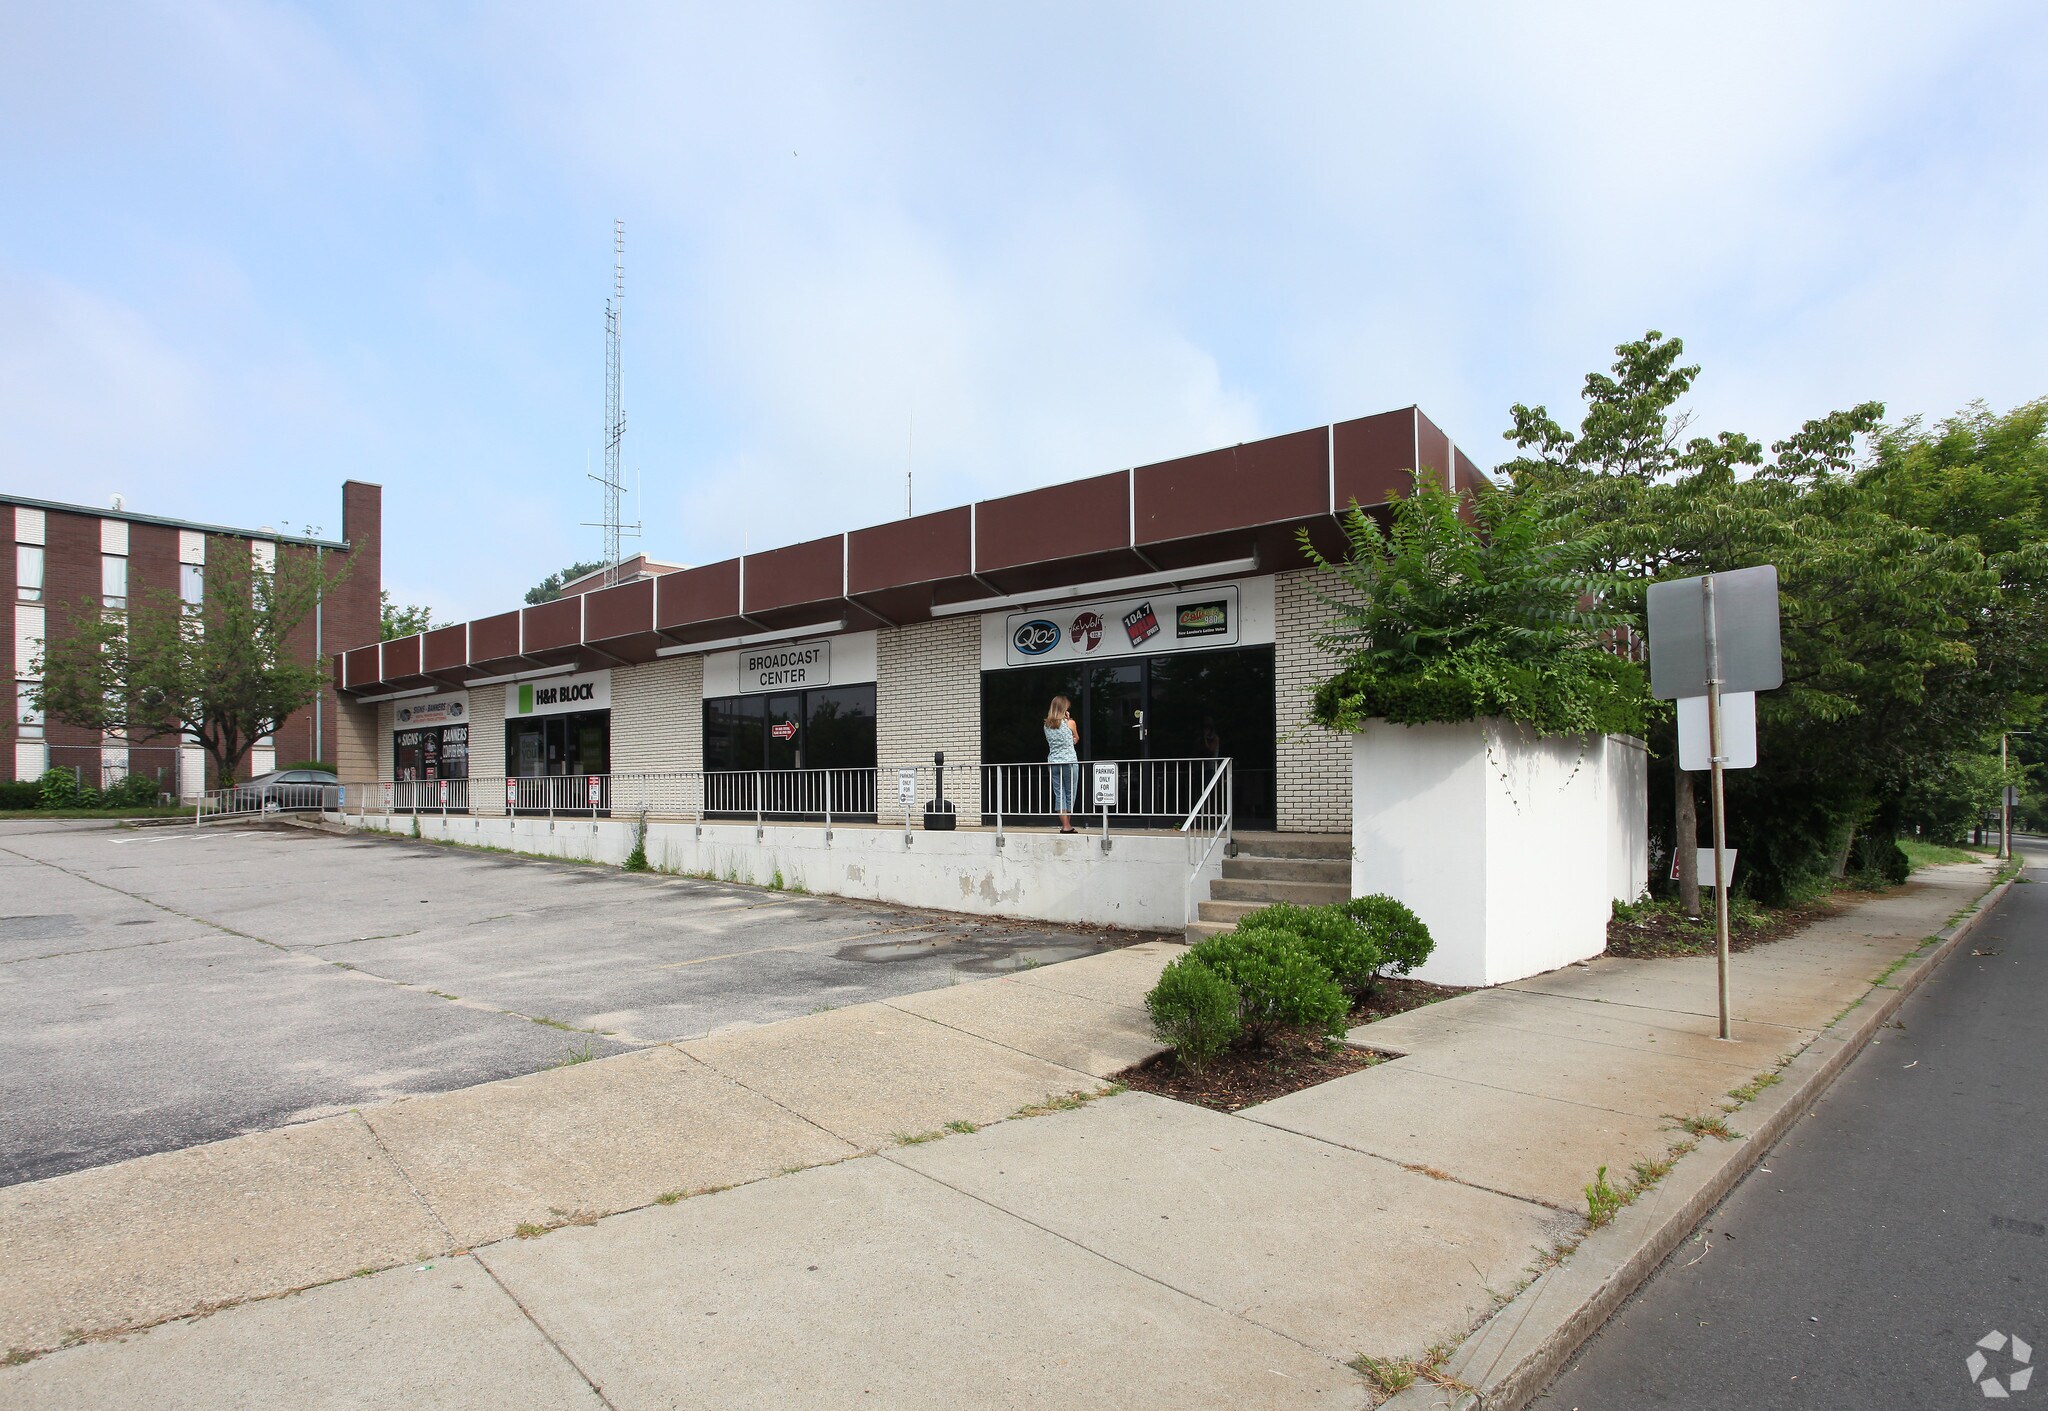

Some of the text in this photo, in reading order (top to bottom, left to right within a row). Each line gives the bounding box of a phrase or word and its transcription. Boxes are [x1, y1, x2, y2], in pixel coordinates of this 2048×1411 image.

[1124, 603, 1150, 627] 104.7
[1204, 615, 1218, 625] 980
[1015, 625, 1058, 650] Q105
[749, 649, 820, 671] BROADCAST
[760, 668, 806, 686] CENTER
[536, 682, 594, 705] H&R BLOCK
[401, 732, 419, 746] SIGNS
[443, 728, 468, 742] BANNERS
